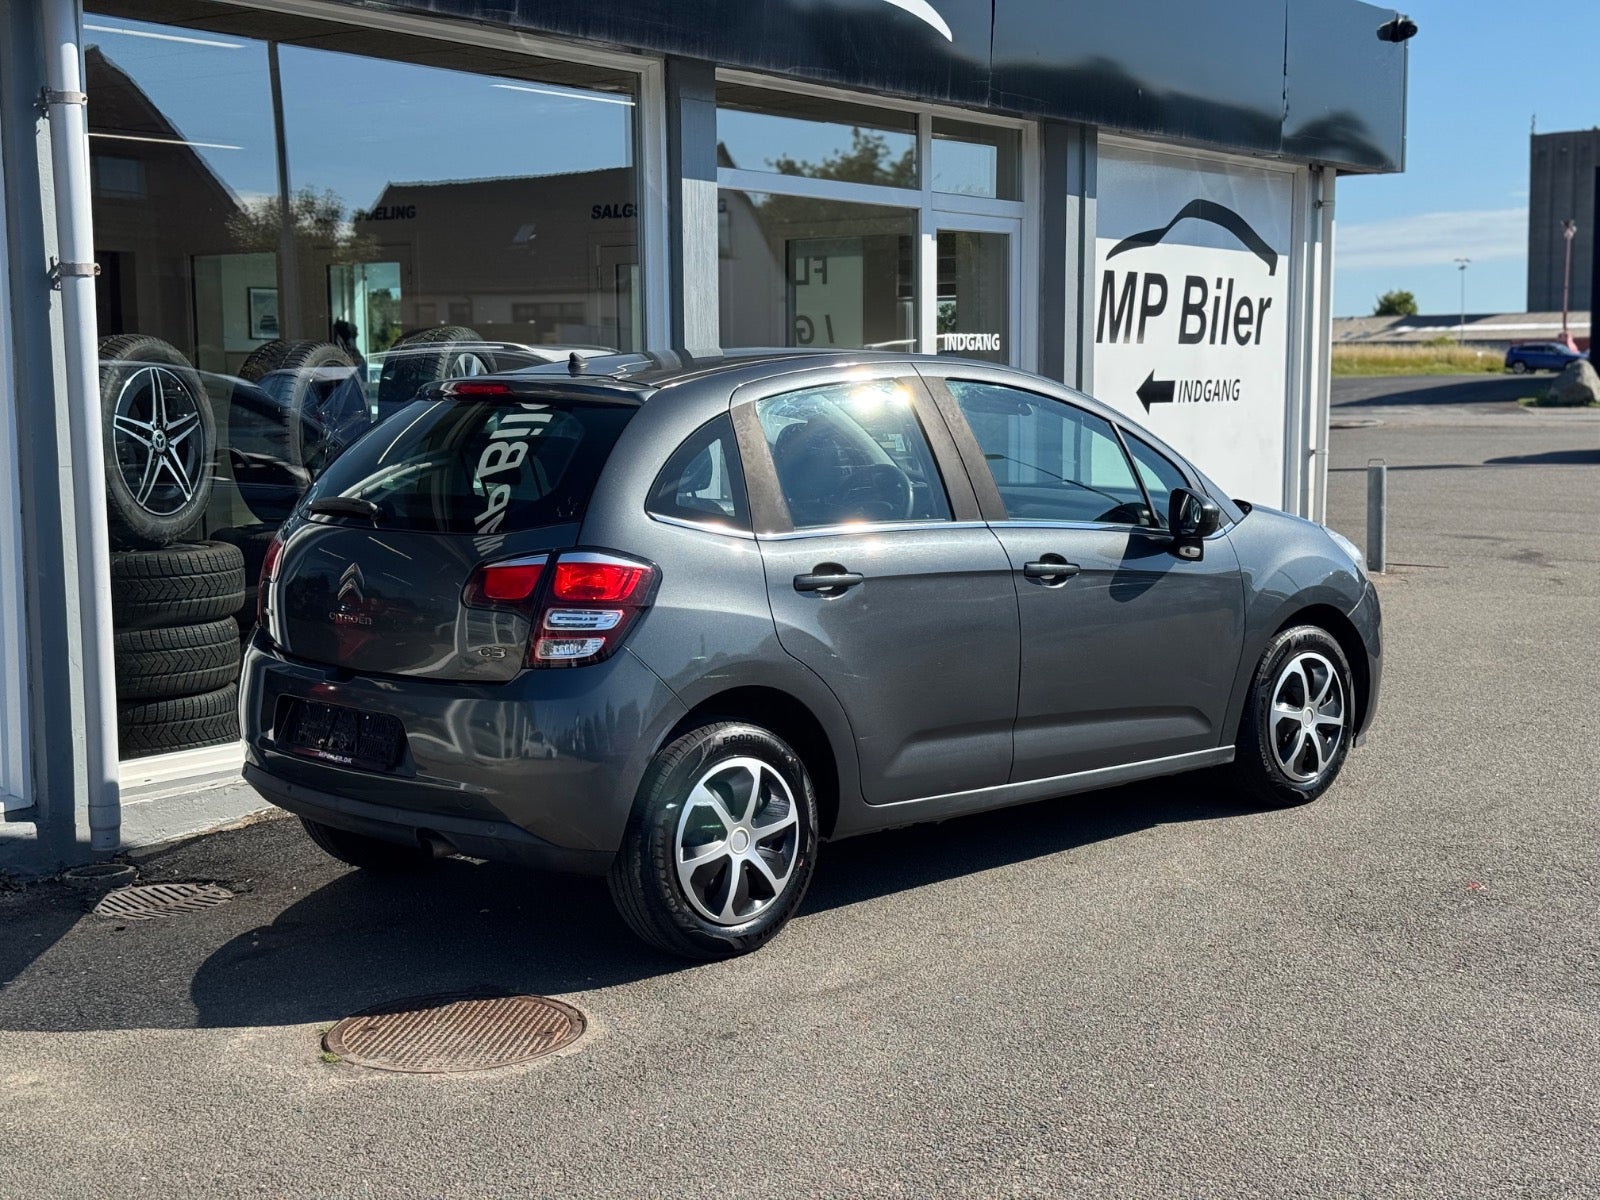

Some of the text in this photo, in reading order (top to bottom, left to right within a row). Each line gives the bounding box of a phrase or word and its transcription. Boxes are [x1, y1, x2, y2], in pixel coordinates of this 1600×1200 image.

[1095, 270, 1272, 346] MP Biler
[944, 333, 1000, 351] INDGANG
[1178, 379, 1241, 403] INDGANG
[477, 646, 507, 659] C3
